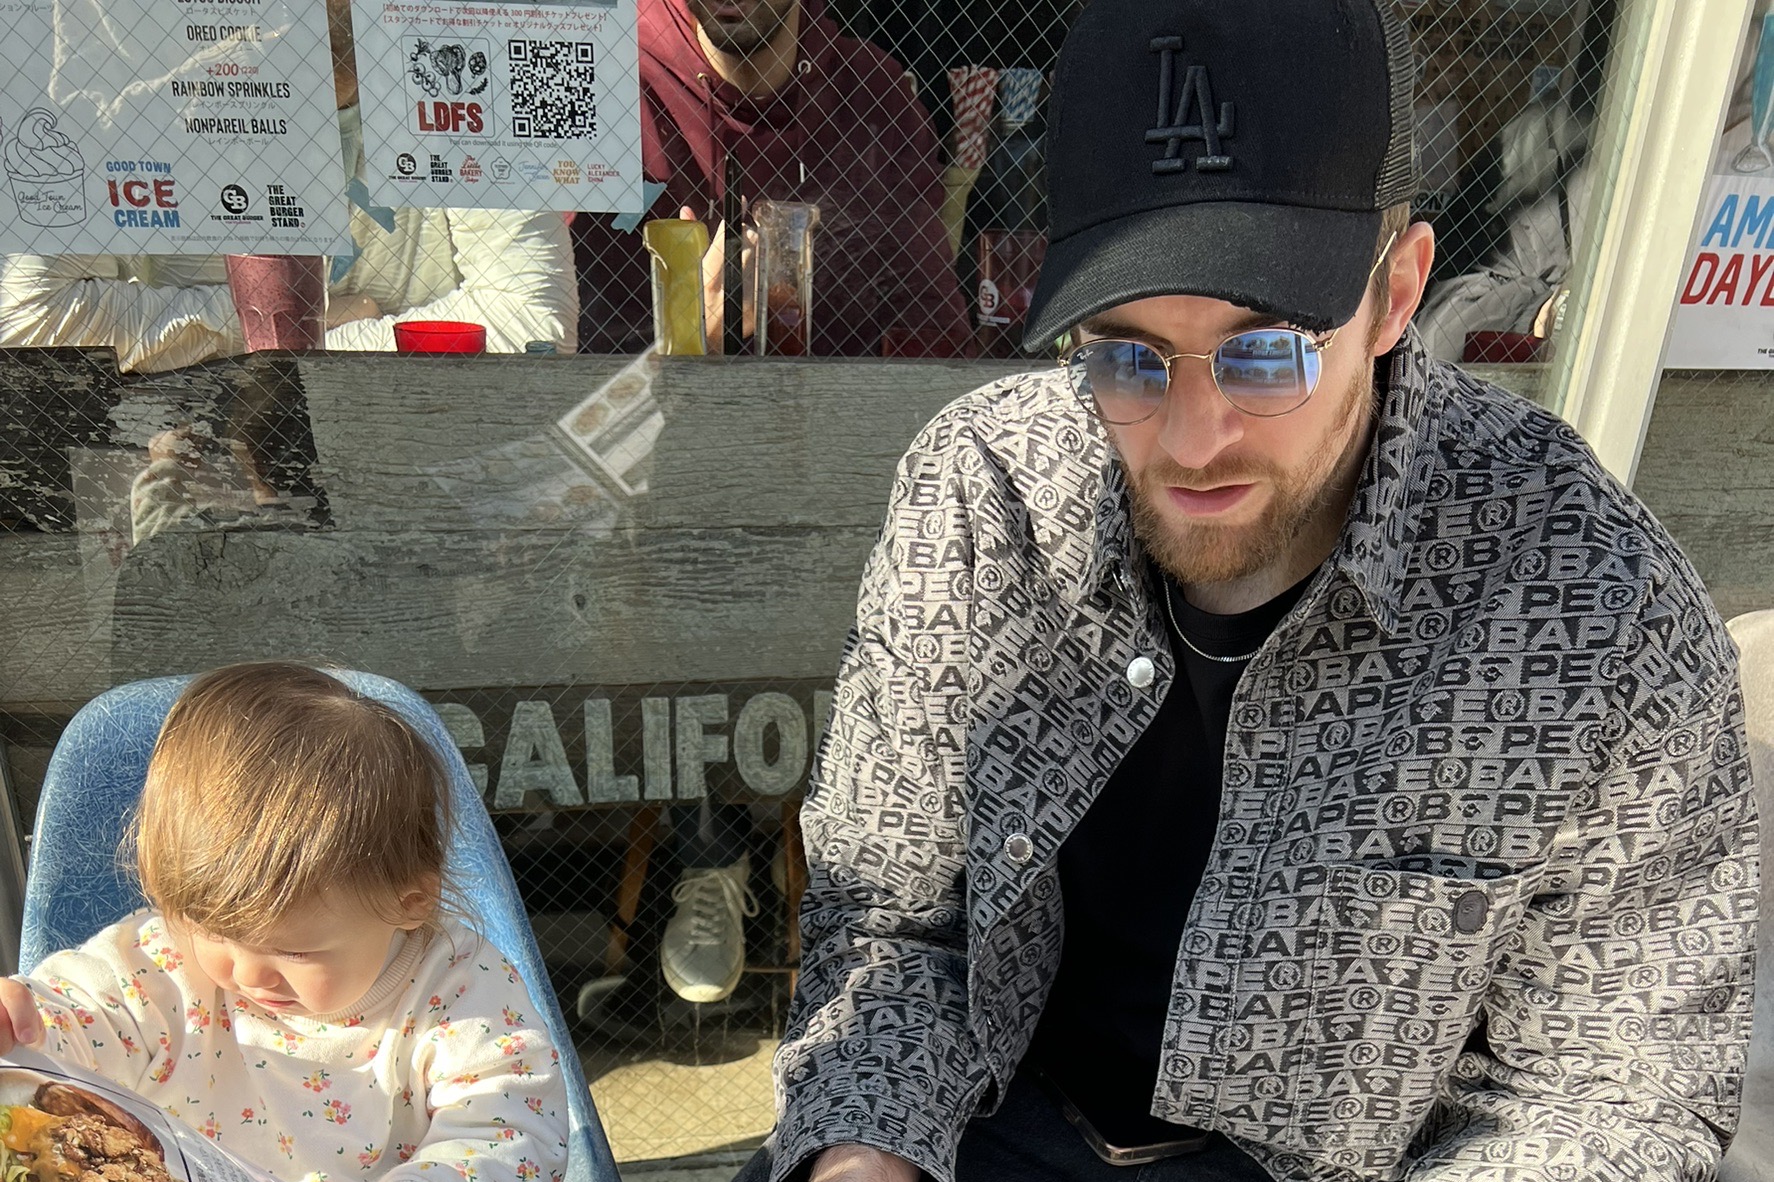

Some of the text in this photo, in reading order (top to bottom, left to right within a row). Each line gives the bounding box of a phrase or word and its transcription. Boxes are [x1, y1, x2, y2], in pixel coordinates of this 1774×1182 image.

[186, 25, 262, 42] OREO COOKIE
[207, 63, 239, 76] +200
[171, 81, 290, 98] RAINBOW SPRINKLES
[1145, 35, 1236, 175] LA
[417, 101, 484, 134] LDFS
[185, 118, 287, 135] NONPAREIL BALLS
[106, 161, 171, 173] GOOD TOWN
[558, 160, 575, 168] YOU
[460, 169, 482, 177] BAKERY
[107, 178, 178, 208] ICE
[267, 184, 284, 195] THE
[37, 202, 83, 213] Ice Cream
[268, 196, 296, 206] GREAT
[114, 209, 181, 228] CREAM
[270, 207, 304, 218] BURGER
[1701, 194, 1774, 249] AM
[436, 691, 834, 809] ALIFO
